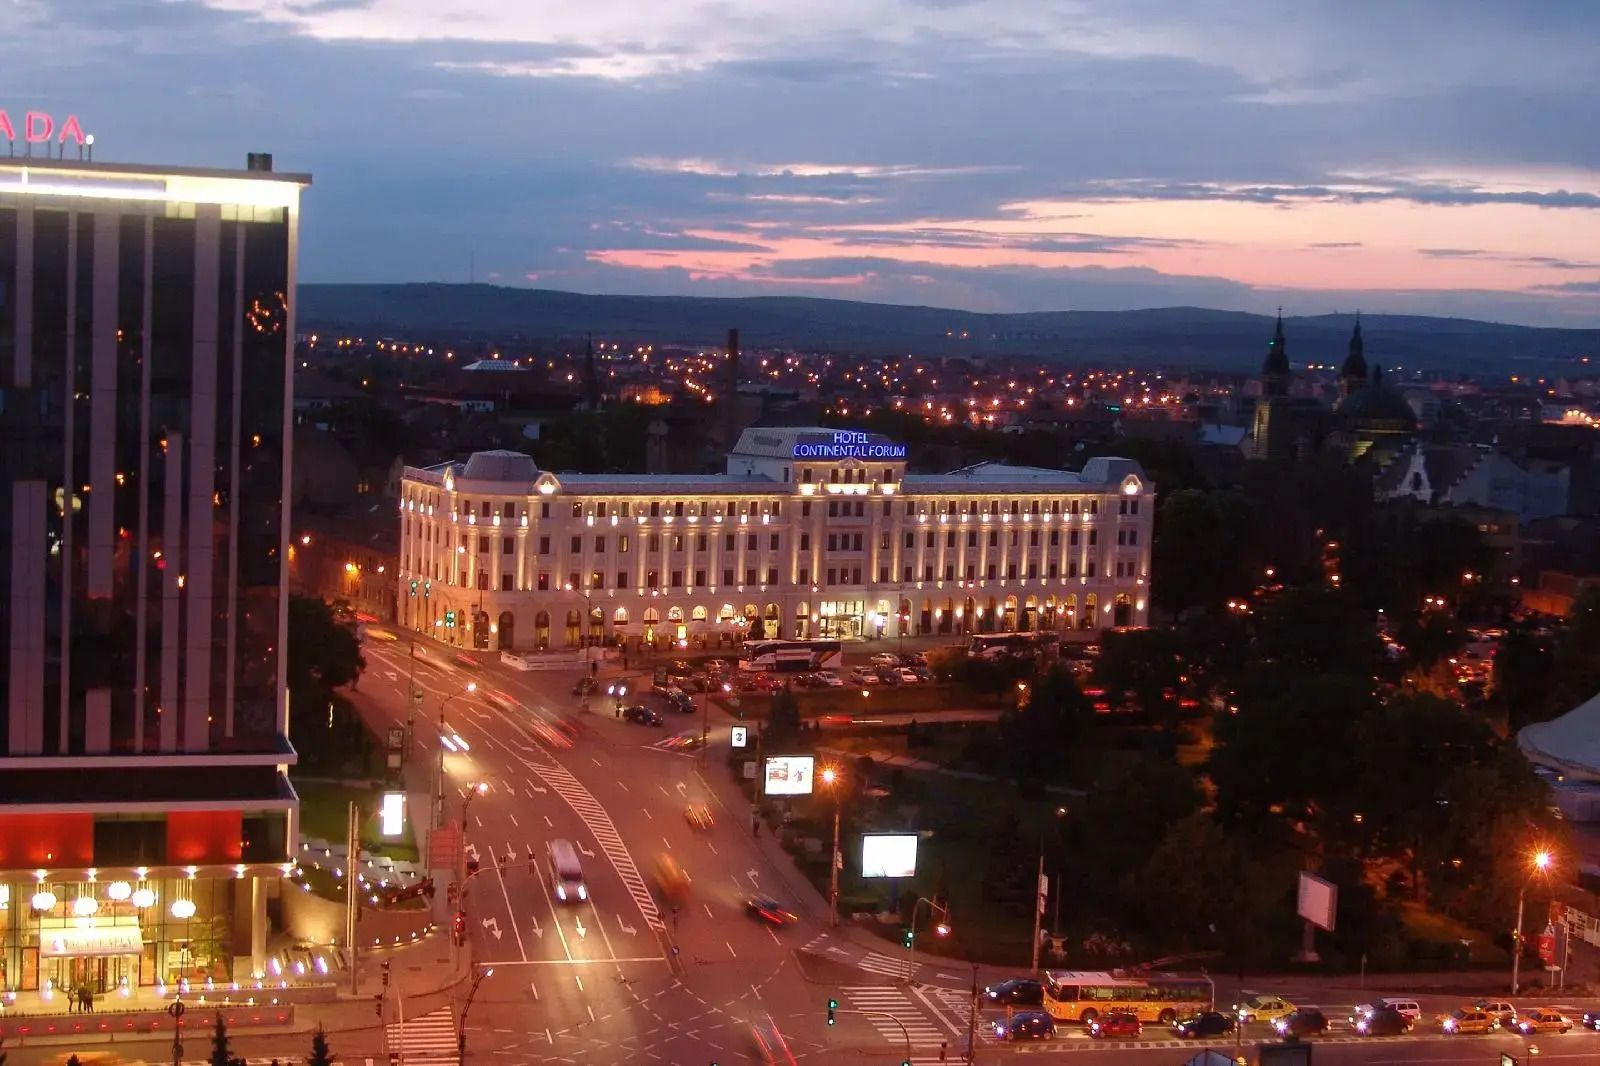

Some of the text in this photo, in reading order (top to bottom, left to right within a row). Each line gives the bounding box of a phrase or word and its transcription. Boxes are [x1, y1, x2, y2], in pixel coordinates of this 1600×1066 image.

[833, 432, 869, 444] HOTEL
[793, 444, 905, 457] CONTINENTAL FORUM
